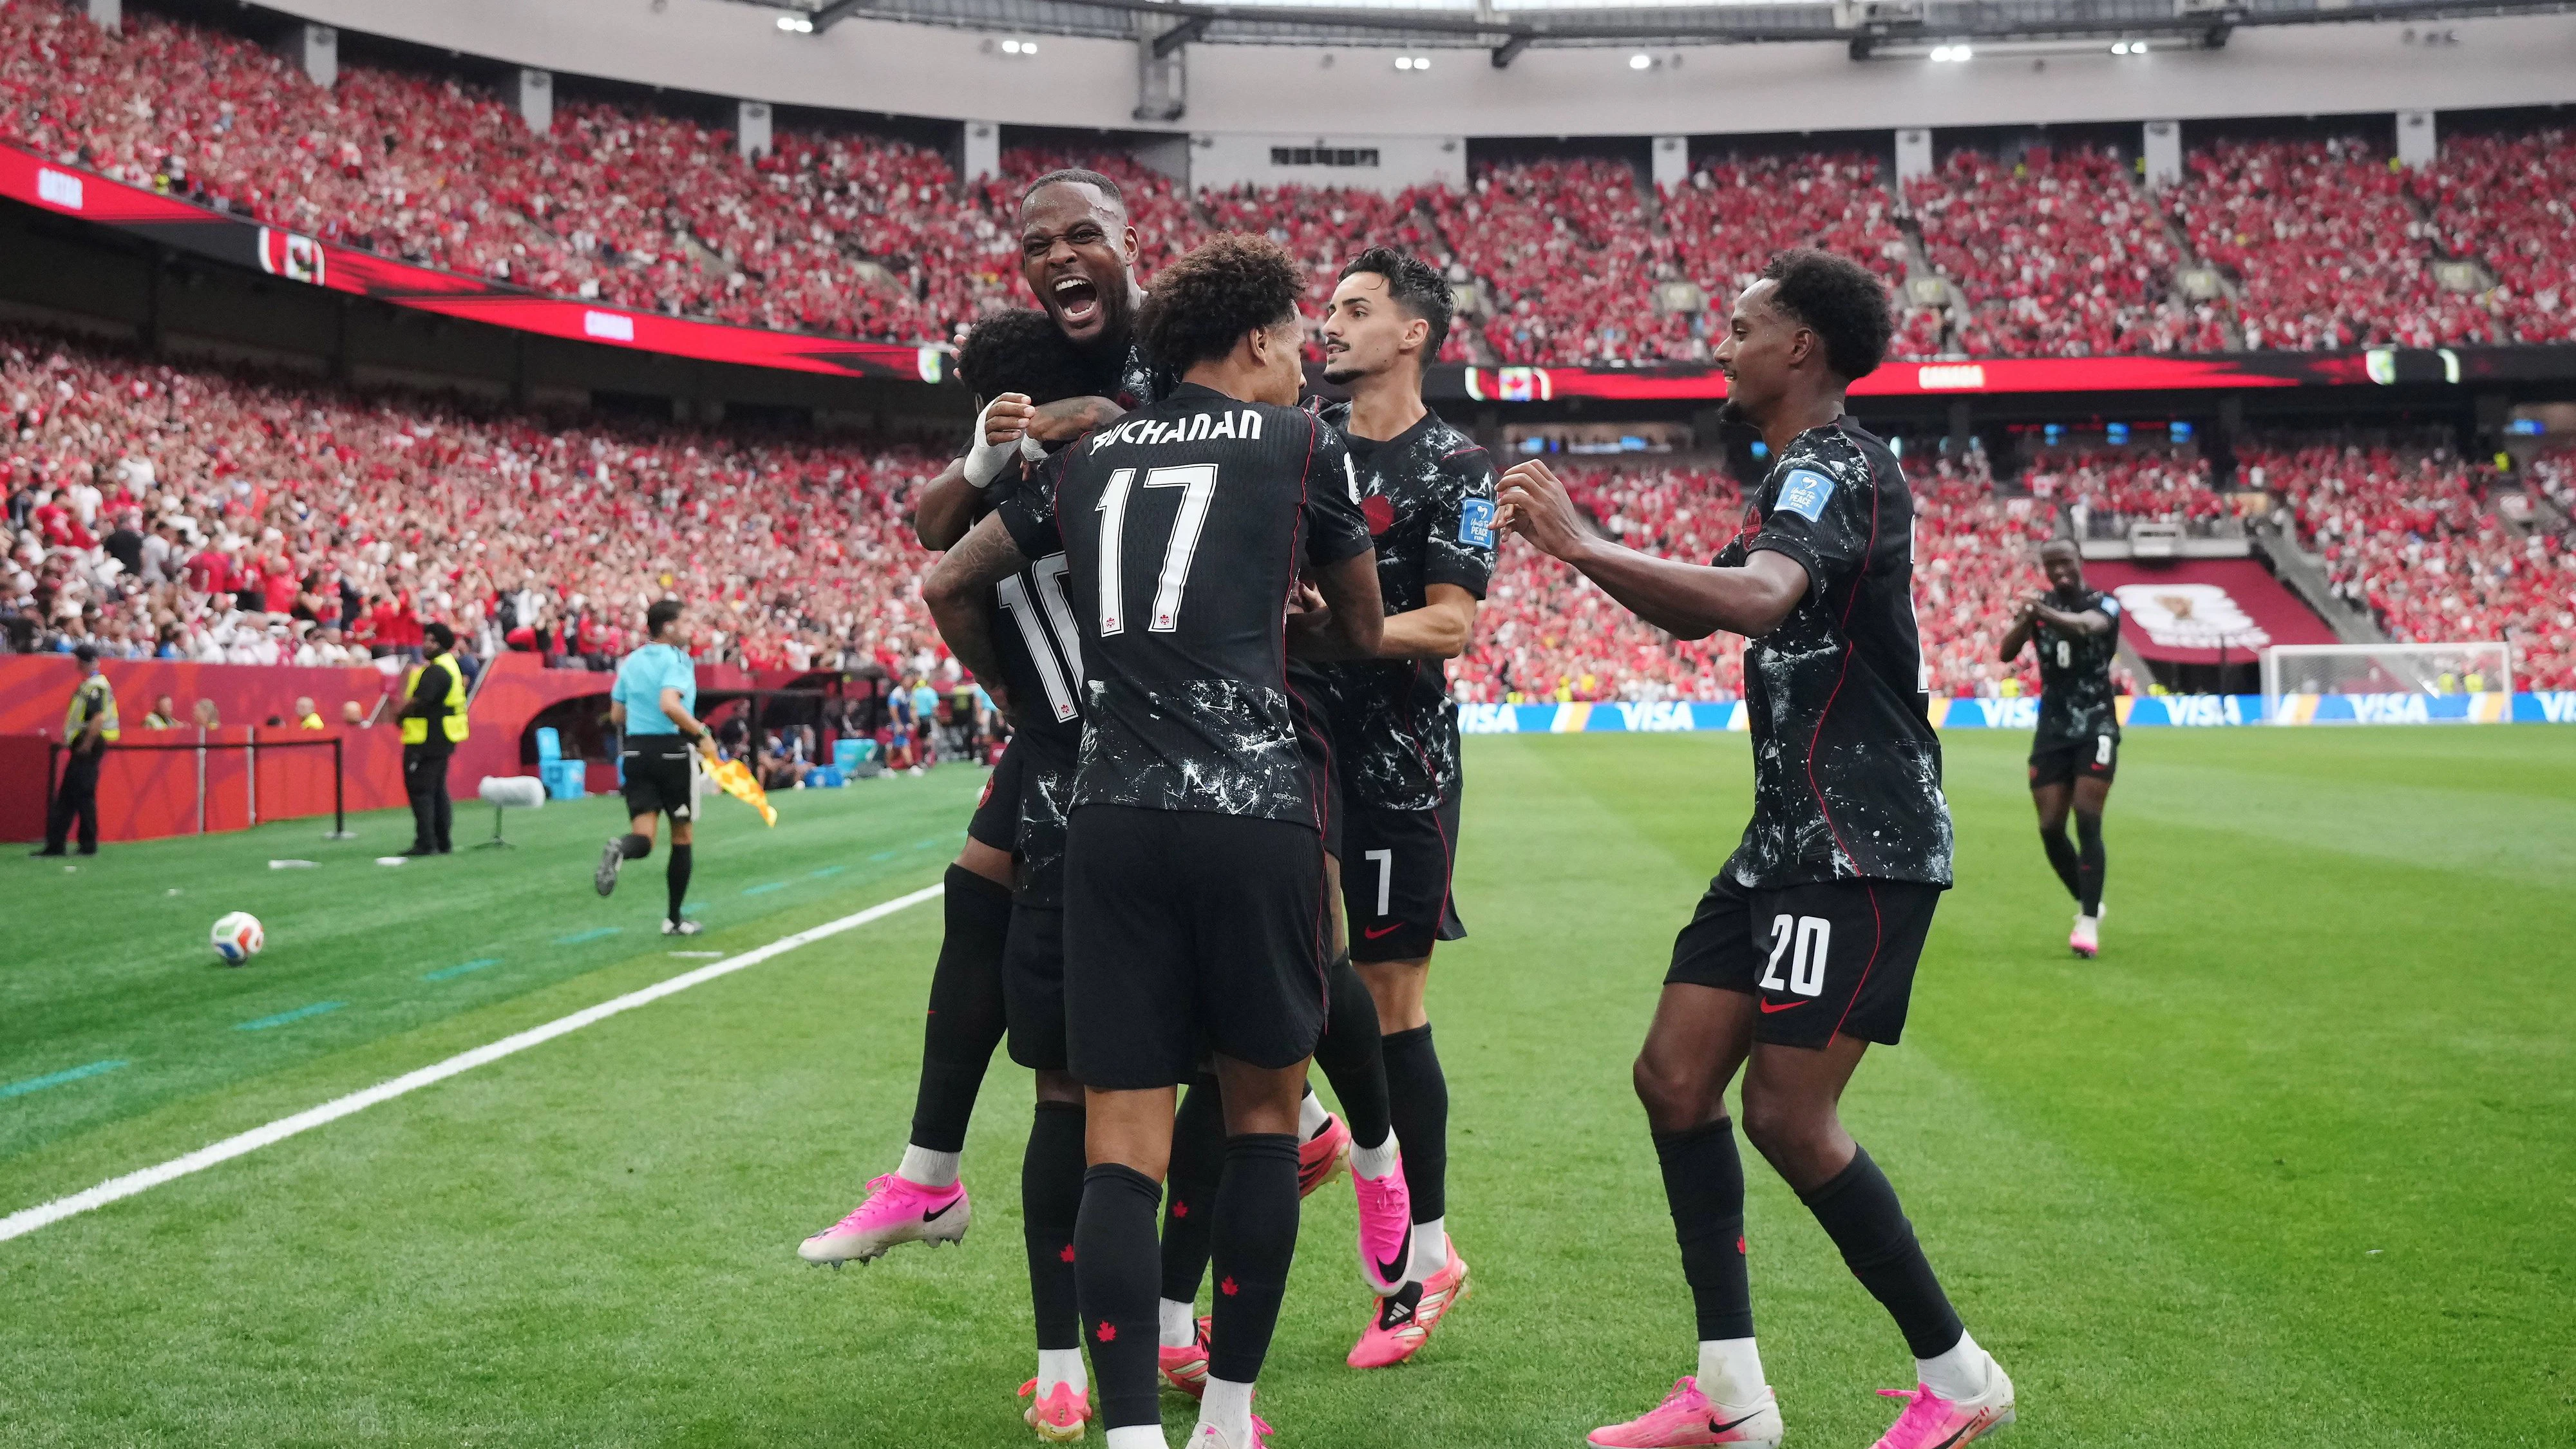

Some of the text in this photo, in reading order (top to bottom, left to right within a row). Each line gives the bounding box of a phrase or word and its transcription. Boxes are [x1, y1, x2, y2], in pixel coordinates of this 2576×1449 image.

[1090, 409, 1262, 455] BUCHANAN
[1788, 494, 1812, 507] PEACE
[1471, 526, 1488, 537] PEACE
[1095, 463, 1219, 638] 17
[2056, 640, 2070, 668] 8
[1614, 701, 1695, 732] VISA
[1974, 697, 2039, 728] VIS
[2159, 694, 2242, 726] VISA
[2344, 693, 2429, 724] VISA
[2533, 691, 2576, 723] VI
[2096, 735, 2111, 764] 8
[1273, 792, 1302, 804] AERO-FIT
[1365, 849, 1392, 916] 7
[1759, 914, 1831, 996] 20
